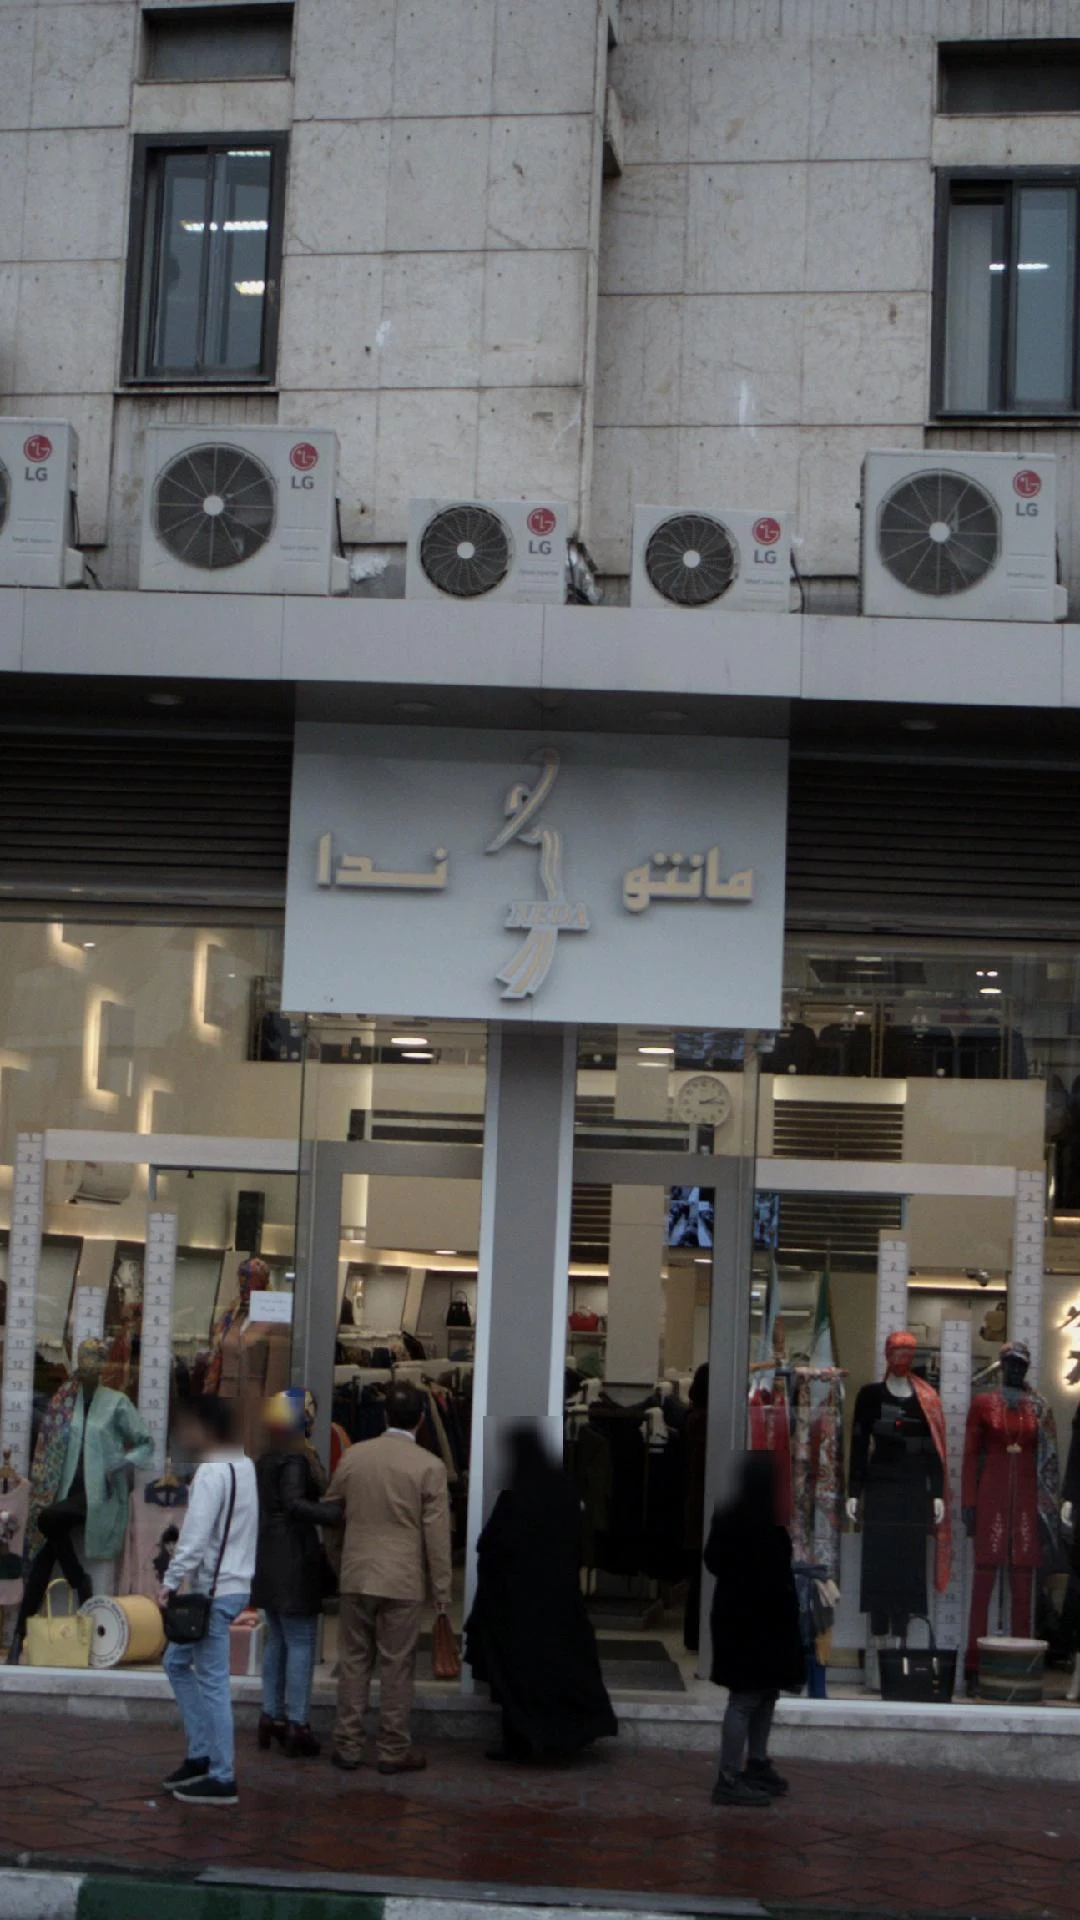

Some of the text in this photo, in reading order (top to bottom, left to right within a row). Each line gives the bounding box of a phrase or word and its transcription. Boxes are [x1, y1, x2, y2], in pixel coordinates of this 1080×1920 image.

[25, 466, 48, 482] LG
[291, 475, 315, 490] LG
[1015, 502, 1039, 517] LG
[528, 540, 552, 556] LG
[753, 549, 777, 565] LG
[317, 831, 752, 912] مانتو ندا
